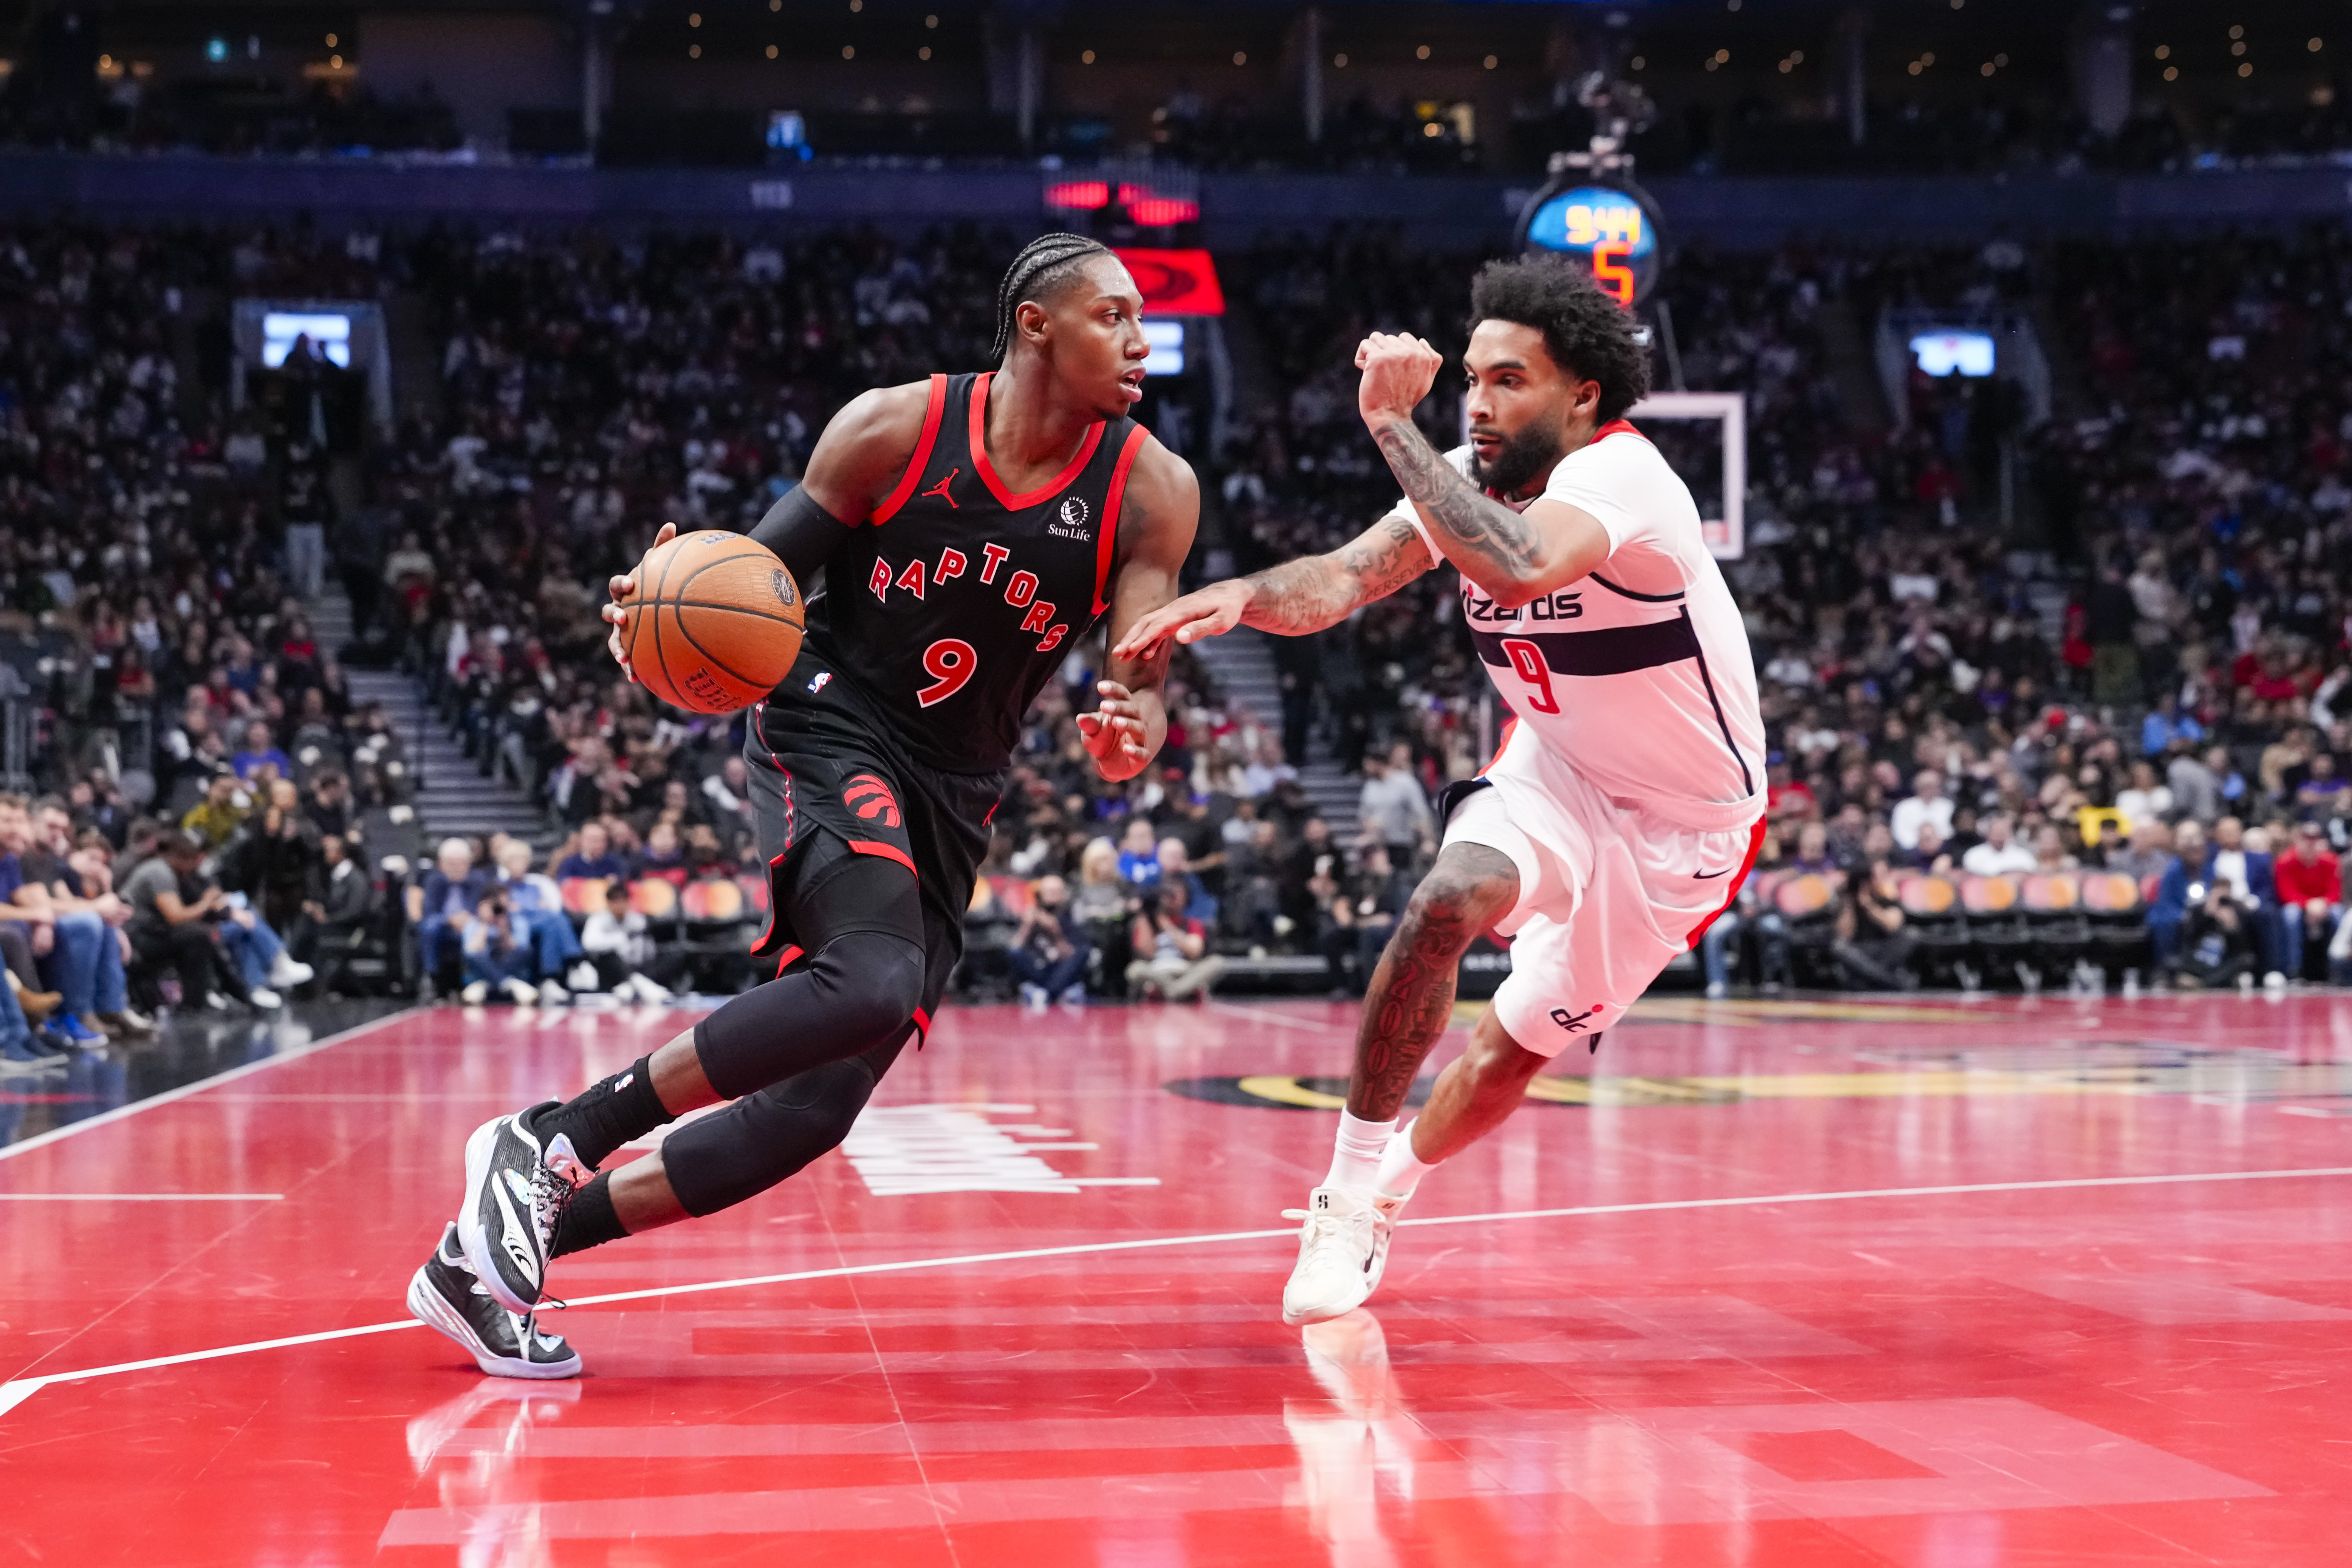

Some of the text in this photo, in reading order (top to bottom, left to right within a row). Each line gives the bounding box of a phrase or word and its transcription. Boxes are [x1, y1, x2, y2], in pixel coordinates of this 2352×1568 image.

[1593, 240, 1634, 306] 5
[1048, 524, 1090, 541] Sun Life
[869, 542, 1068, 652] RAPTORS
[1461, 584, 1583, 621] izads
[917, 638, 977, 708] 9
[1500, 639, 1561, 714] 9
